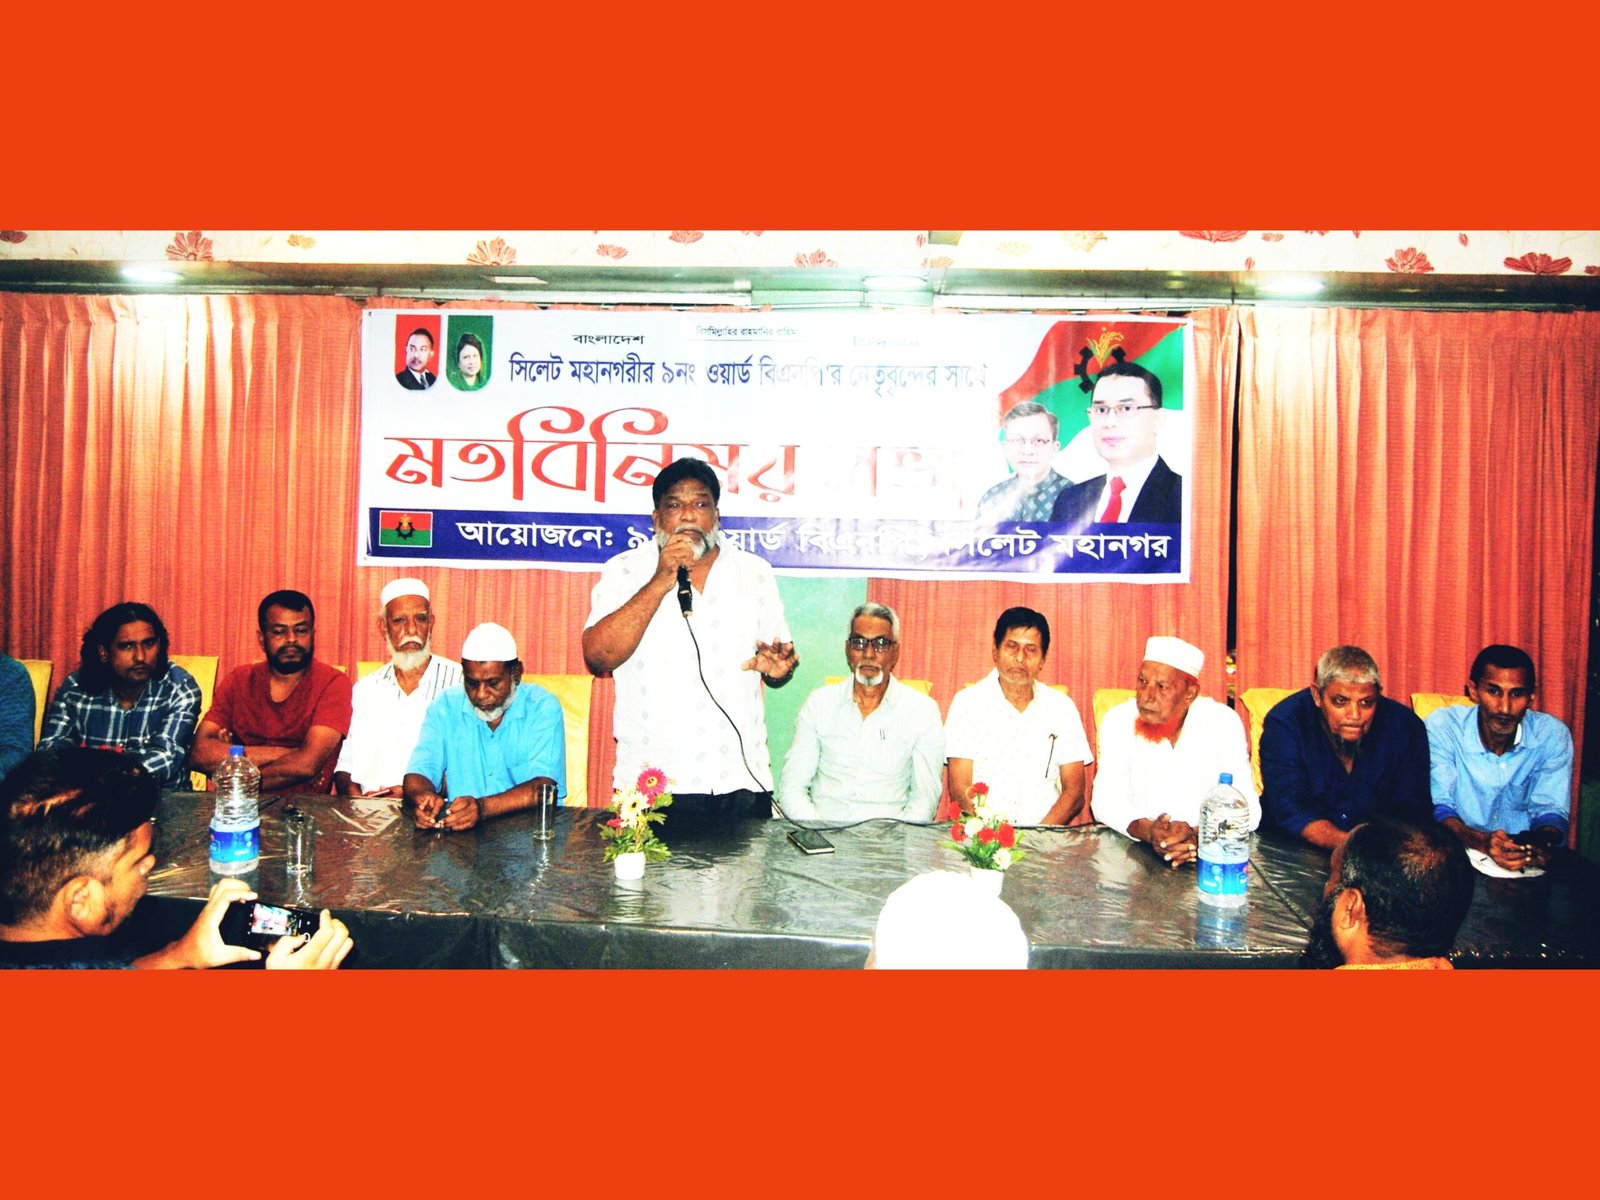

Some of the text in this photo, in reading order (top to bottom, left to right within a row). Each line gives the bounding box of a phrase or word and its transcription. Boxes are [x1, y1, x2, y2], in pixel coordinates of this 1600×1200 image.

[572, 334, 645, 345] বাংলাদেশ
[509, 351, 564, 382] সিলেট
[568, 352, 655, 384] মহানগরীর
[662, 361, 696, 386] ৯নং
[706, 354, 753, 385] ওয়ার্ড
[456, 519, 613, 550] আয়োজনে:
[720, 521, 790, 552] য়ার্ড
[1048, 532, 1172, 560] মহানগর
